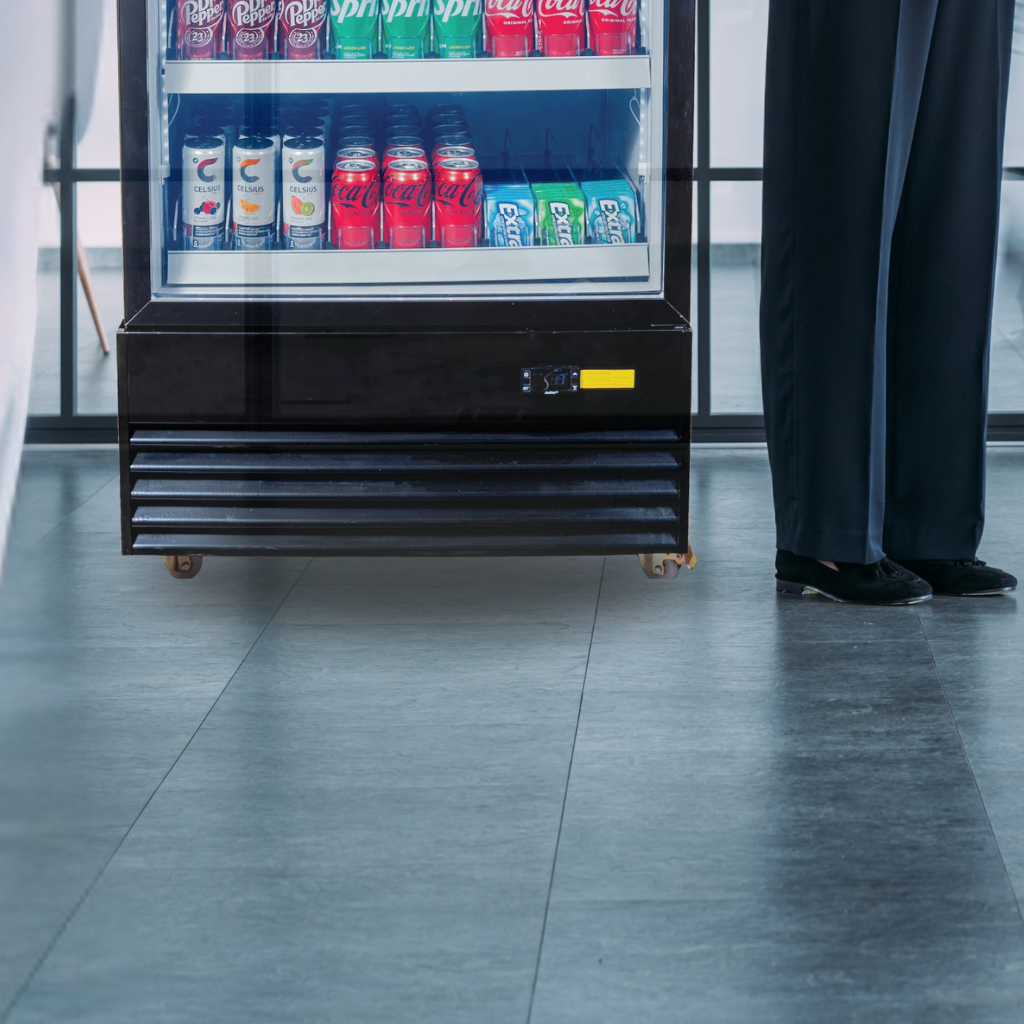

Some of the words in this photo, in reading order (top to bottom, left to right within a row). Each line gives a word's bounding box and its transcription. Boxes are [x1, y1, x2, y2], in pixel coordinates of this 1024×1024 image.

[234, 0, 275, 27] Pepper
[287, 0, 327, 27] Pepper
[193, 184, 221, 193] CELSIUS
[237, 184, 265, 193] CELSIUS
[289, 185, 318, 193] CELSIUS
